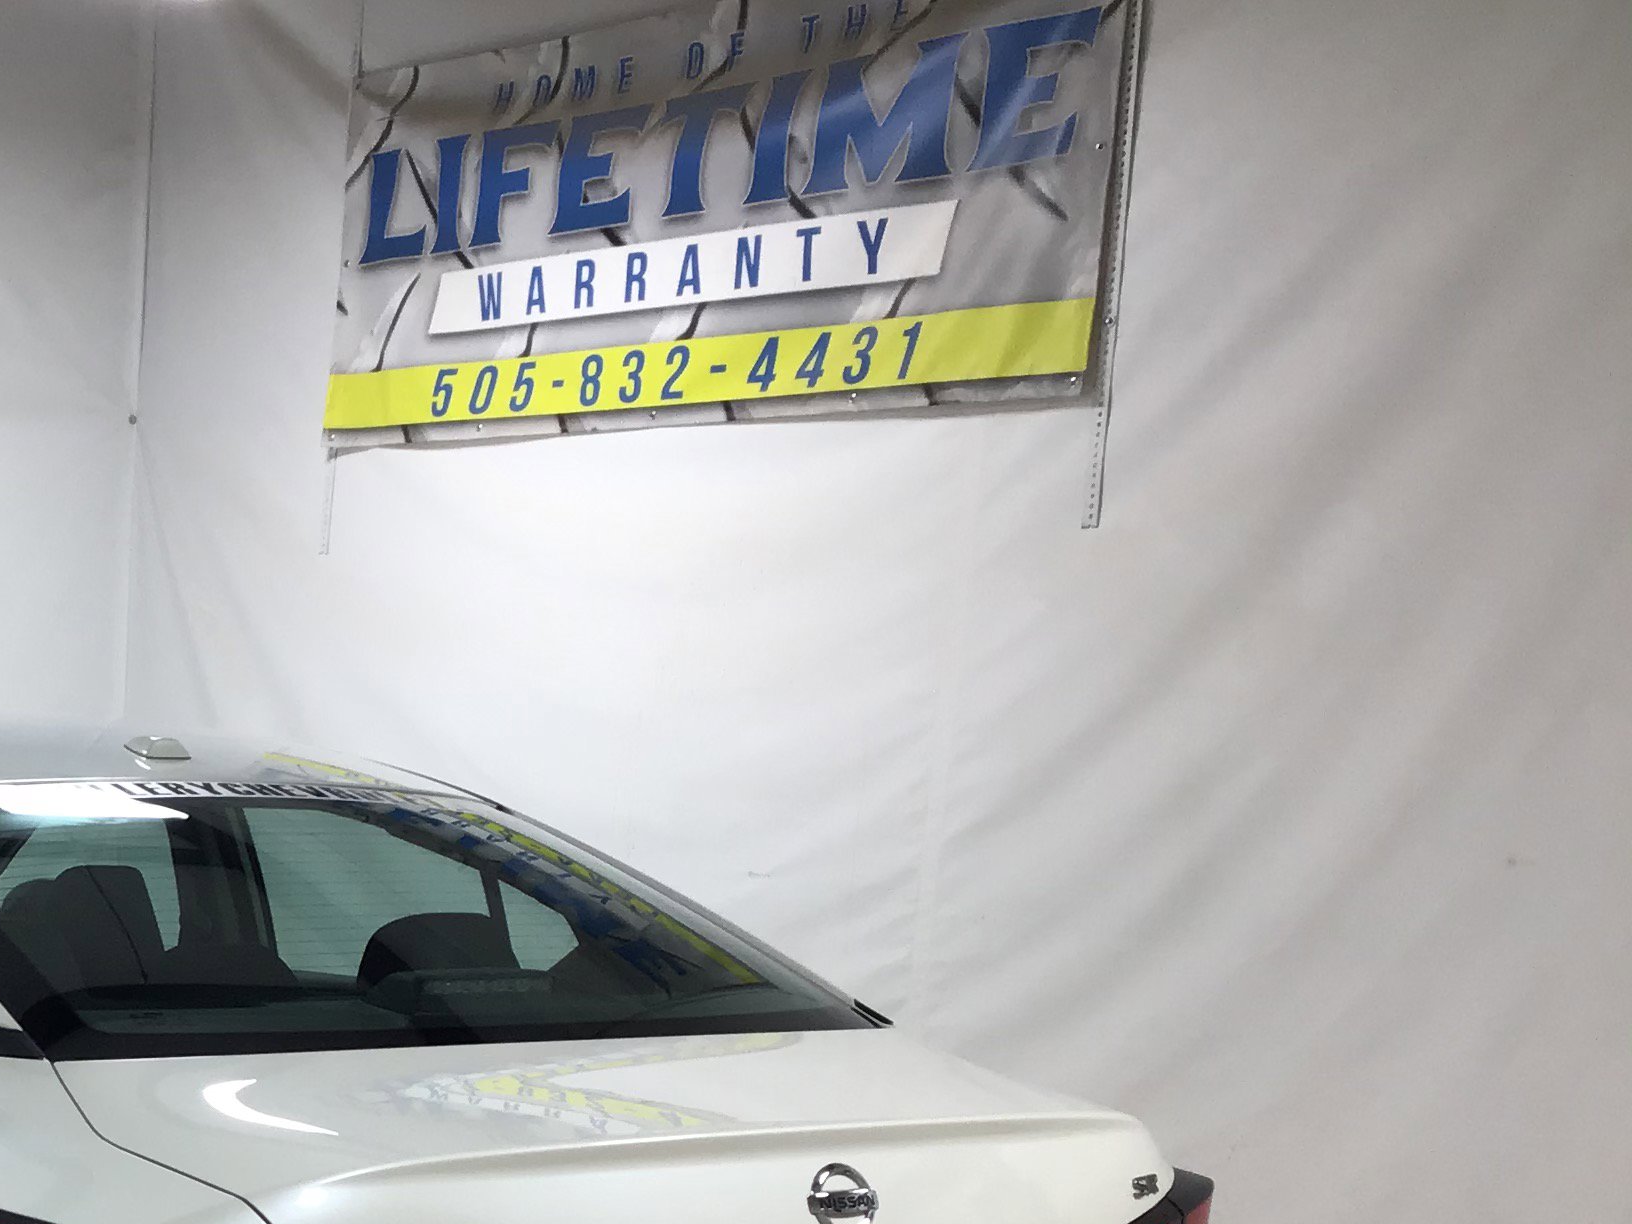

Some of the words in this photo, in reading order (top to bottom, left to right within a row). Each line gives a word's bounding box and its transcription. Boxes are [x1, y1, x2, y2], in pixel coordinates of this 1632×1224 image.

[493, 56, 635, 113] HOME
[684, 31, 746, 82] OF
[801, 0, 910, 53] THE
[359, 6, 1106, 266] LIFETIME
[478, 217, 891, 323] WARRANTY
[430, 321, 925, 418] 505-832-4431
